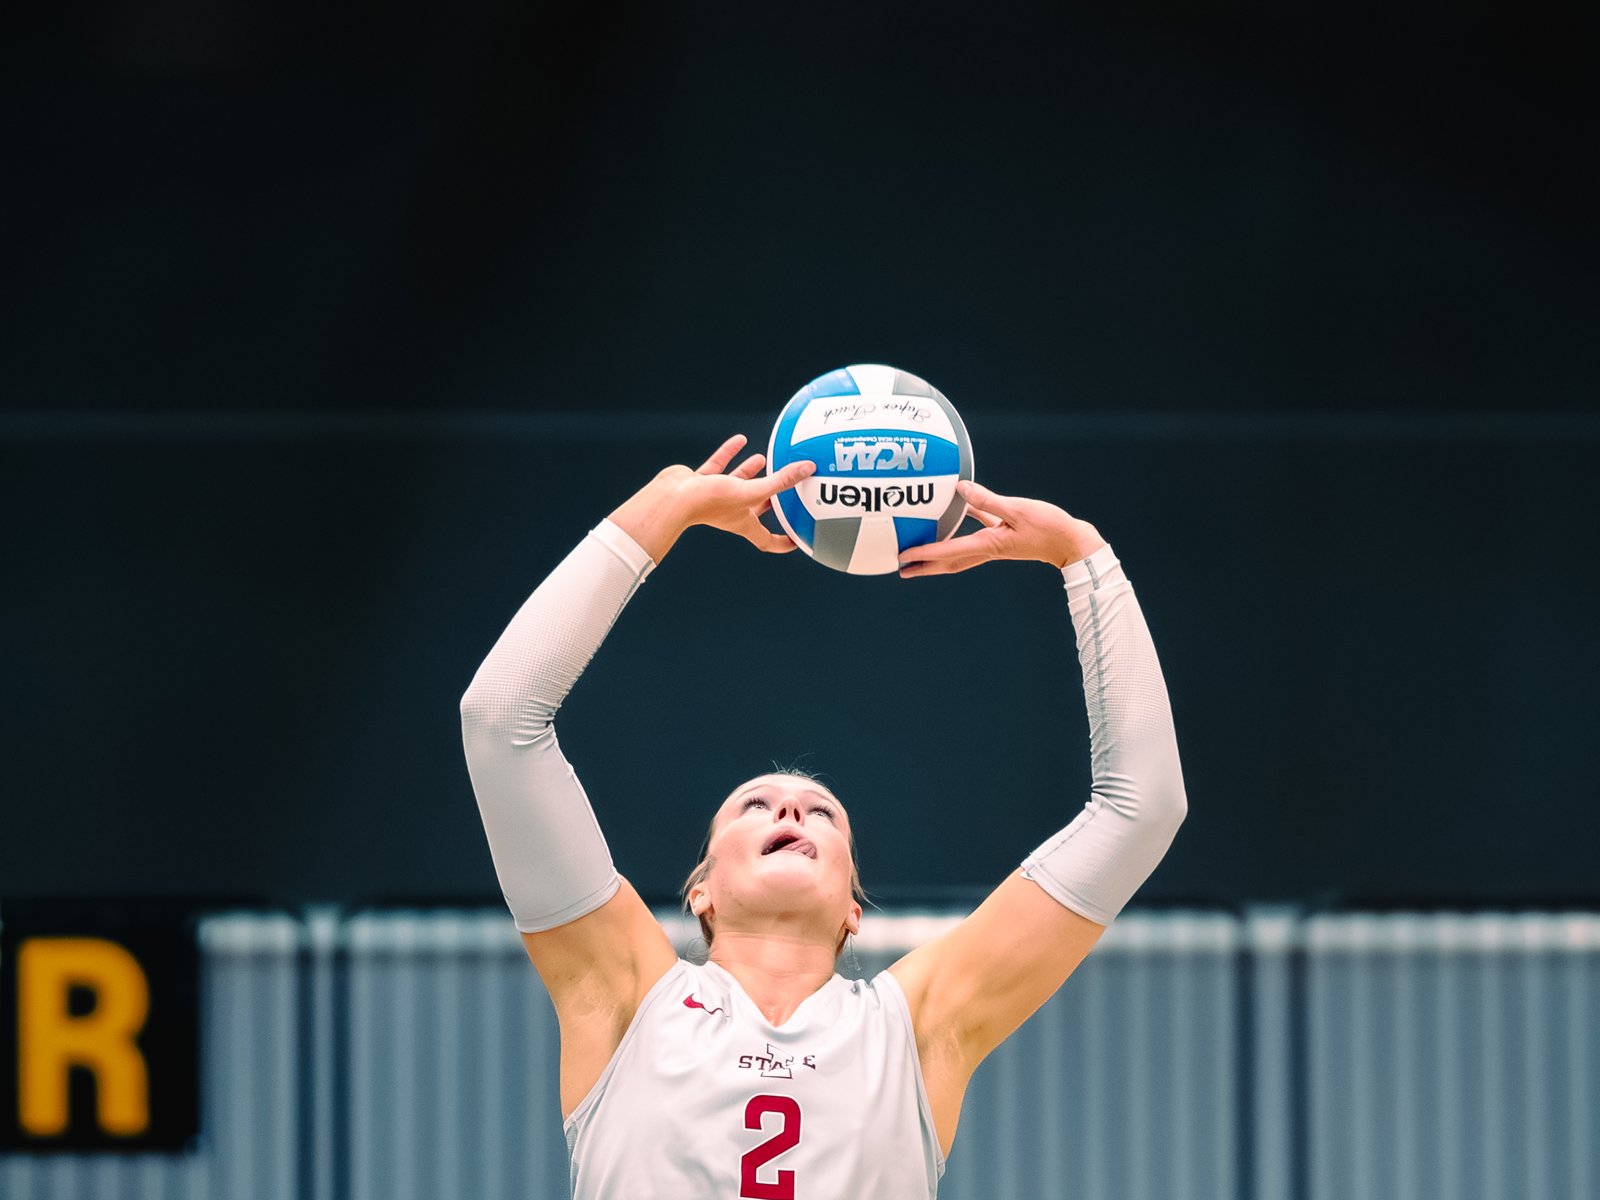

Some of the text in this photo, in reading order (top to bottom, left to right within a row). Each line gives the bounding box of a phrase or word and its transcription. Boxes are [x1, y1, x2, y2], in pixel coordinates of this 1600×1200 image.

[824, 401, 931, 425] Super Touch
[834, 441, 927, 472] NCAA
[820, 483, 934, 512] molten
[17, 937, 150, 1137] R
[738, 1055, 816, 1071] STAE
